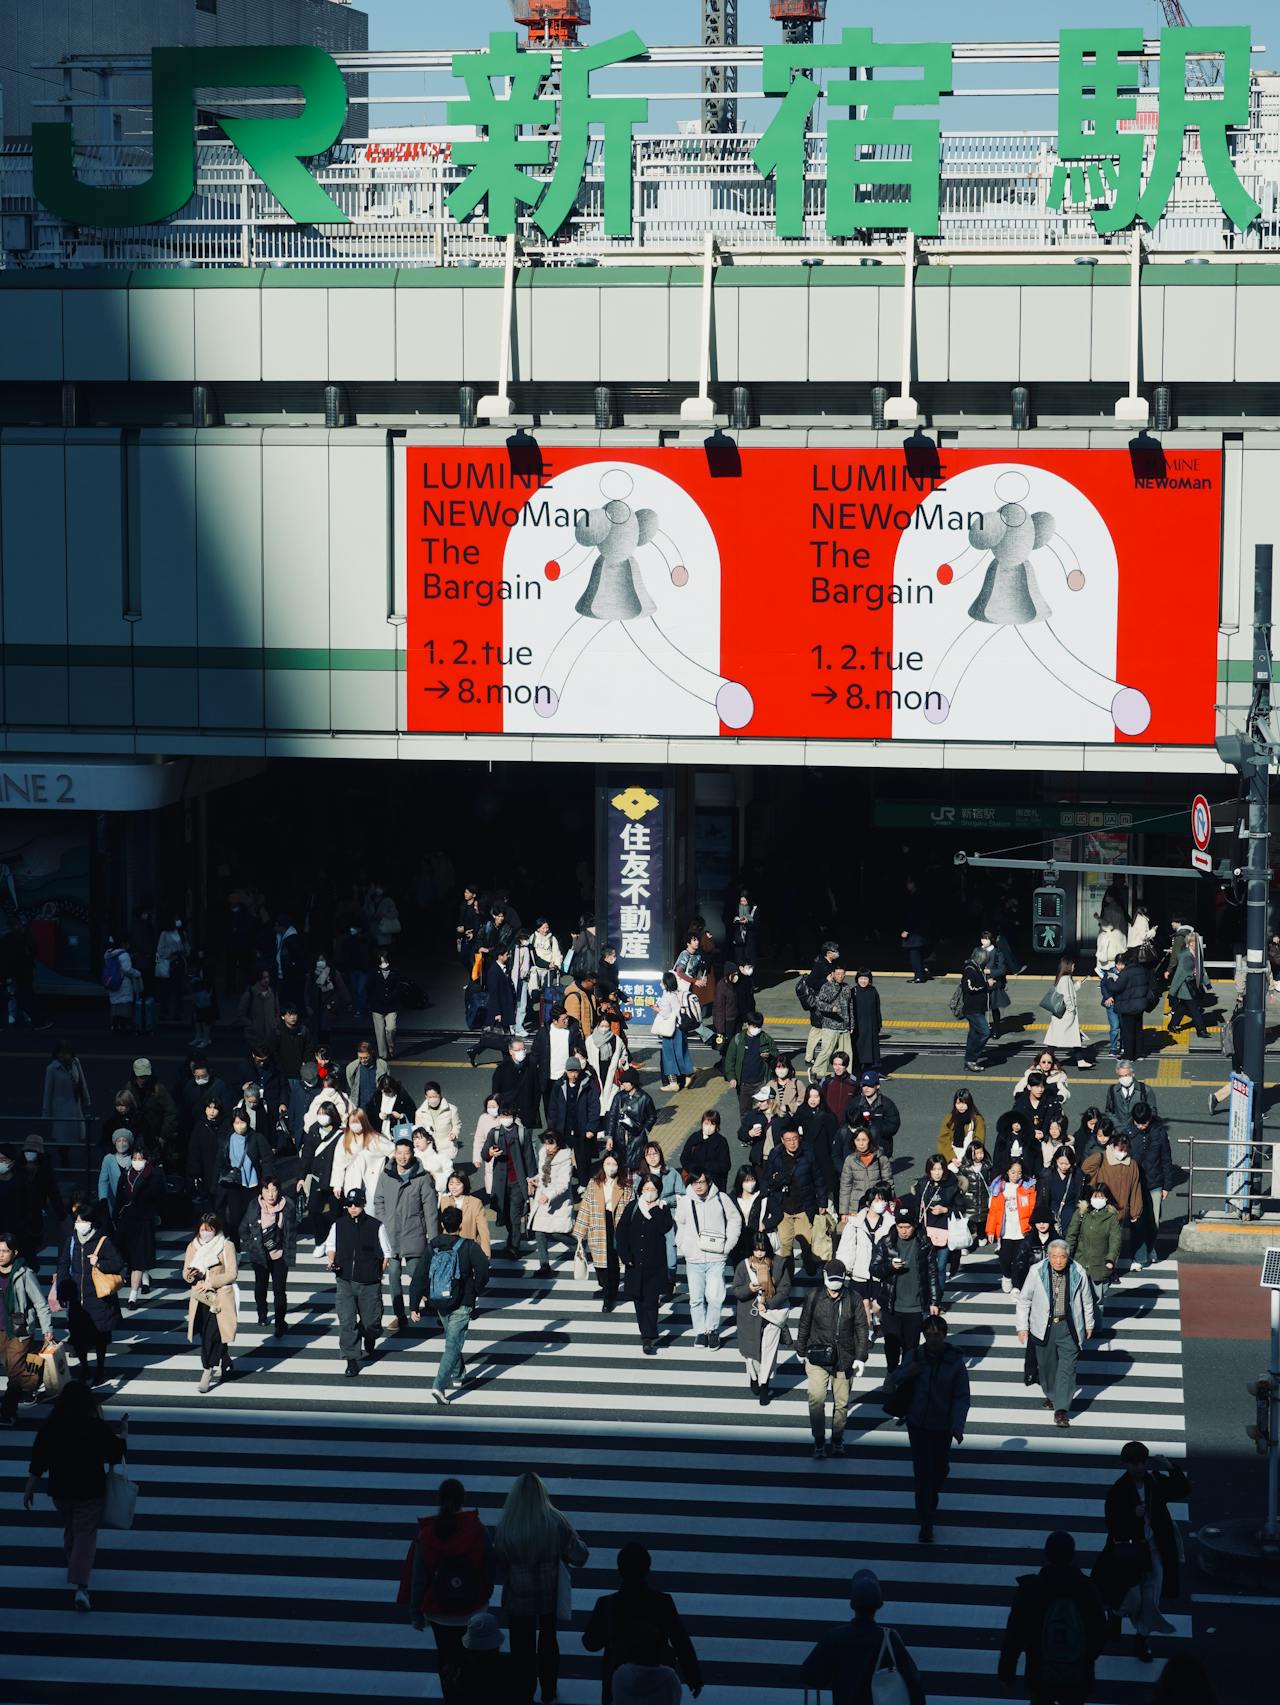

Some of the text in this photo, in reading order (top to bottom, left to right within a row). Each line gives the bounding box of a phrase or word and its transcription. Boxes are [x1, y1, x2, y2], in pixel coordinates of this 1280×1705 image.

[32, 46, 352, 228] JR
[444, 26, 1261, 240] 新宿駅
[422, 463, 554, 490] LUMINE
[811, 464, 948, 492] LUMINE
[1135, 477, 1212, 489] NEWoMan
[421, 500, 591, 528] NEWoMan
[811, 503, 985, 531] NEWoMan
[421, 538, 480, 565] The
[810, 541, 871, 569] The
[422, 573, 542, 606] Bargain
[811, 577, 934, 611] Bargain
[56, 774, 75, 803] 2
[931, 806, 956, 821] JR
[961, 807, 996, 819] 新宿駅
[619, 823, 651, 960] 住友不動産
